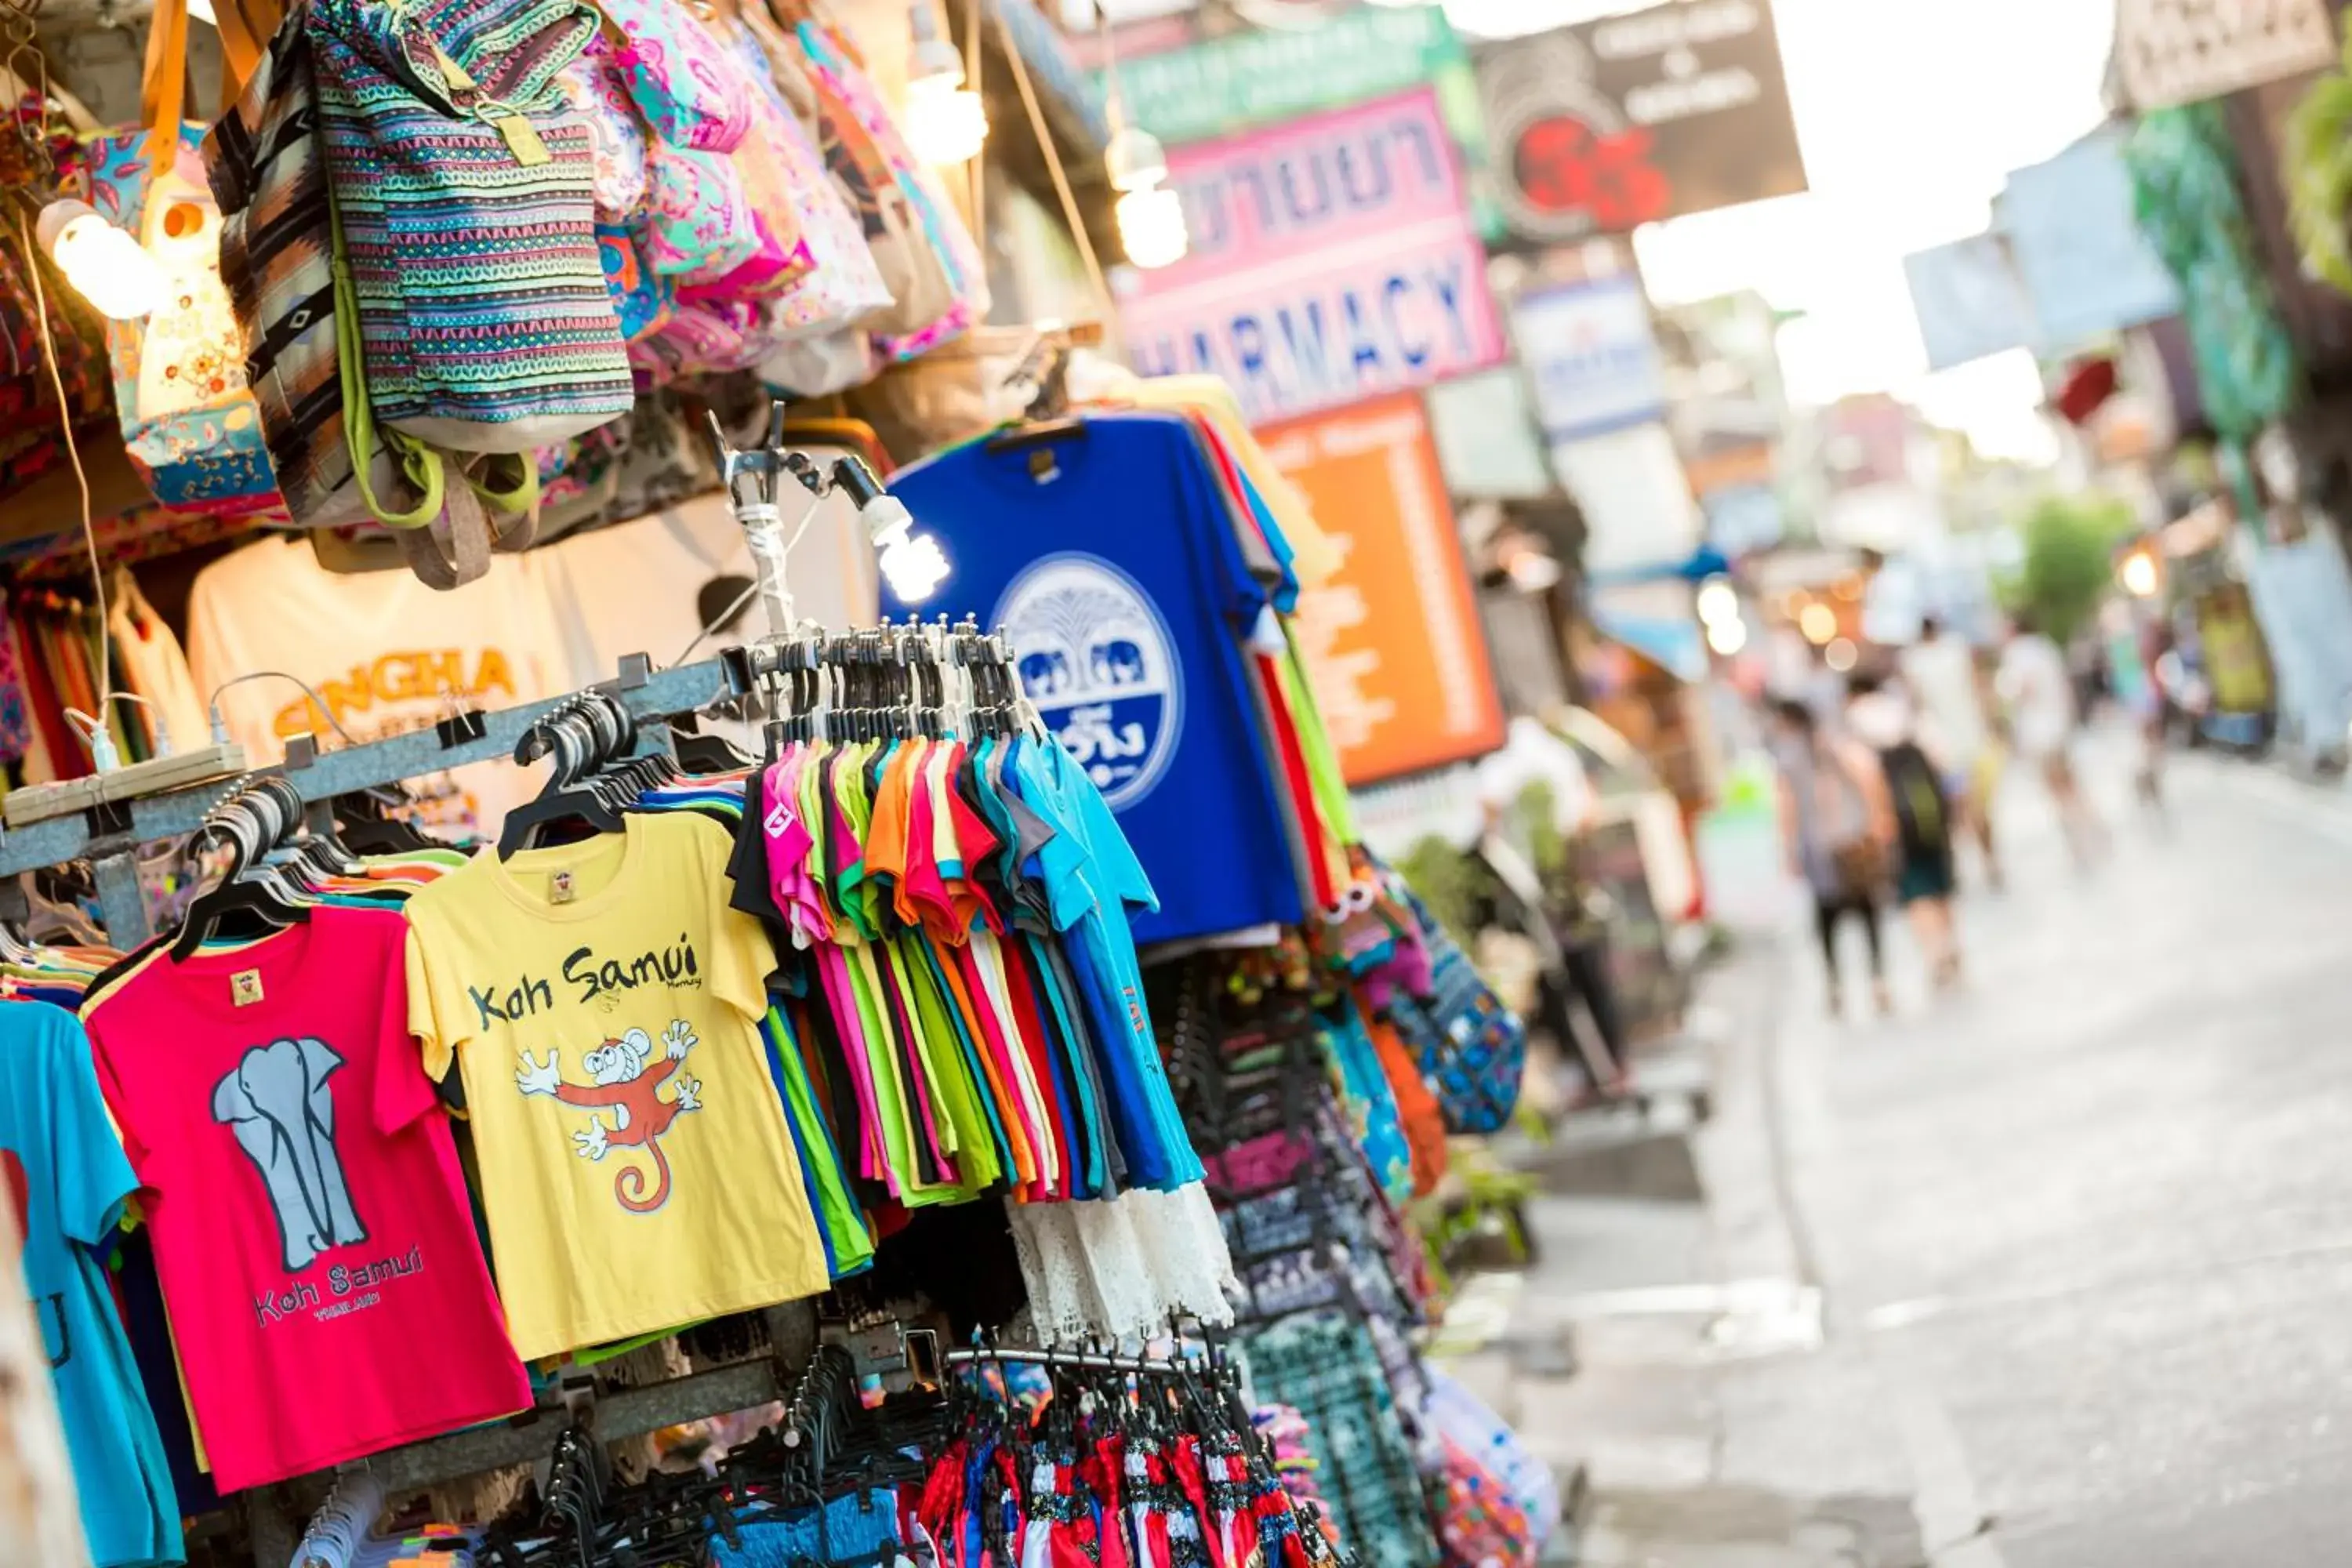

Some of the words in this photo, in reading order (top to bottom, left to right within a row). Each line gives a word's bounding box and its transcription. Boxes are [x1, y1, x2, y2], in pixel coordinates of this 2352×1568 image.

[468, 974, 553, 1033] Koh
[561, 932, 698, 1004] Samui
[254, 1281, 320, 1327] Koh
[328, 1243, 424, 1296] Samui
